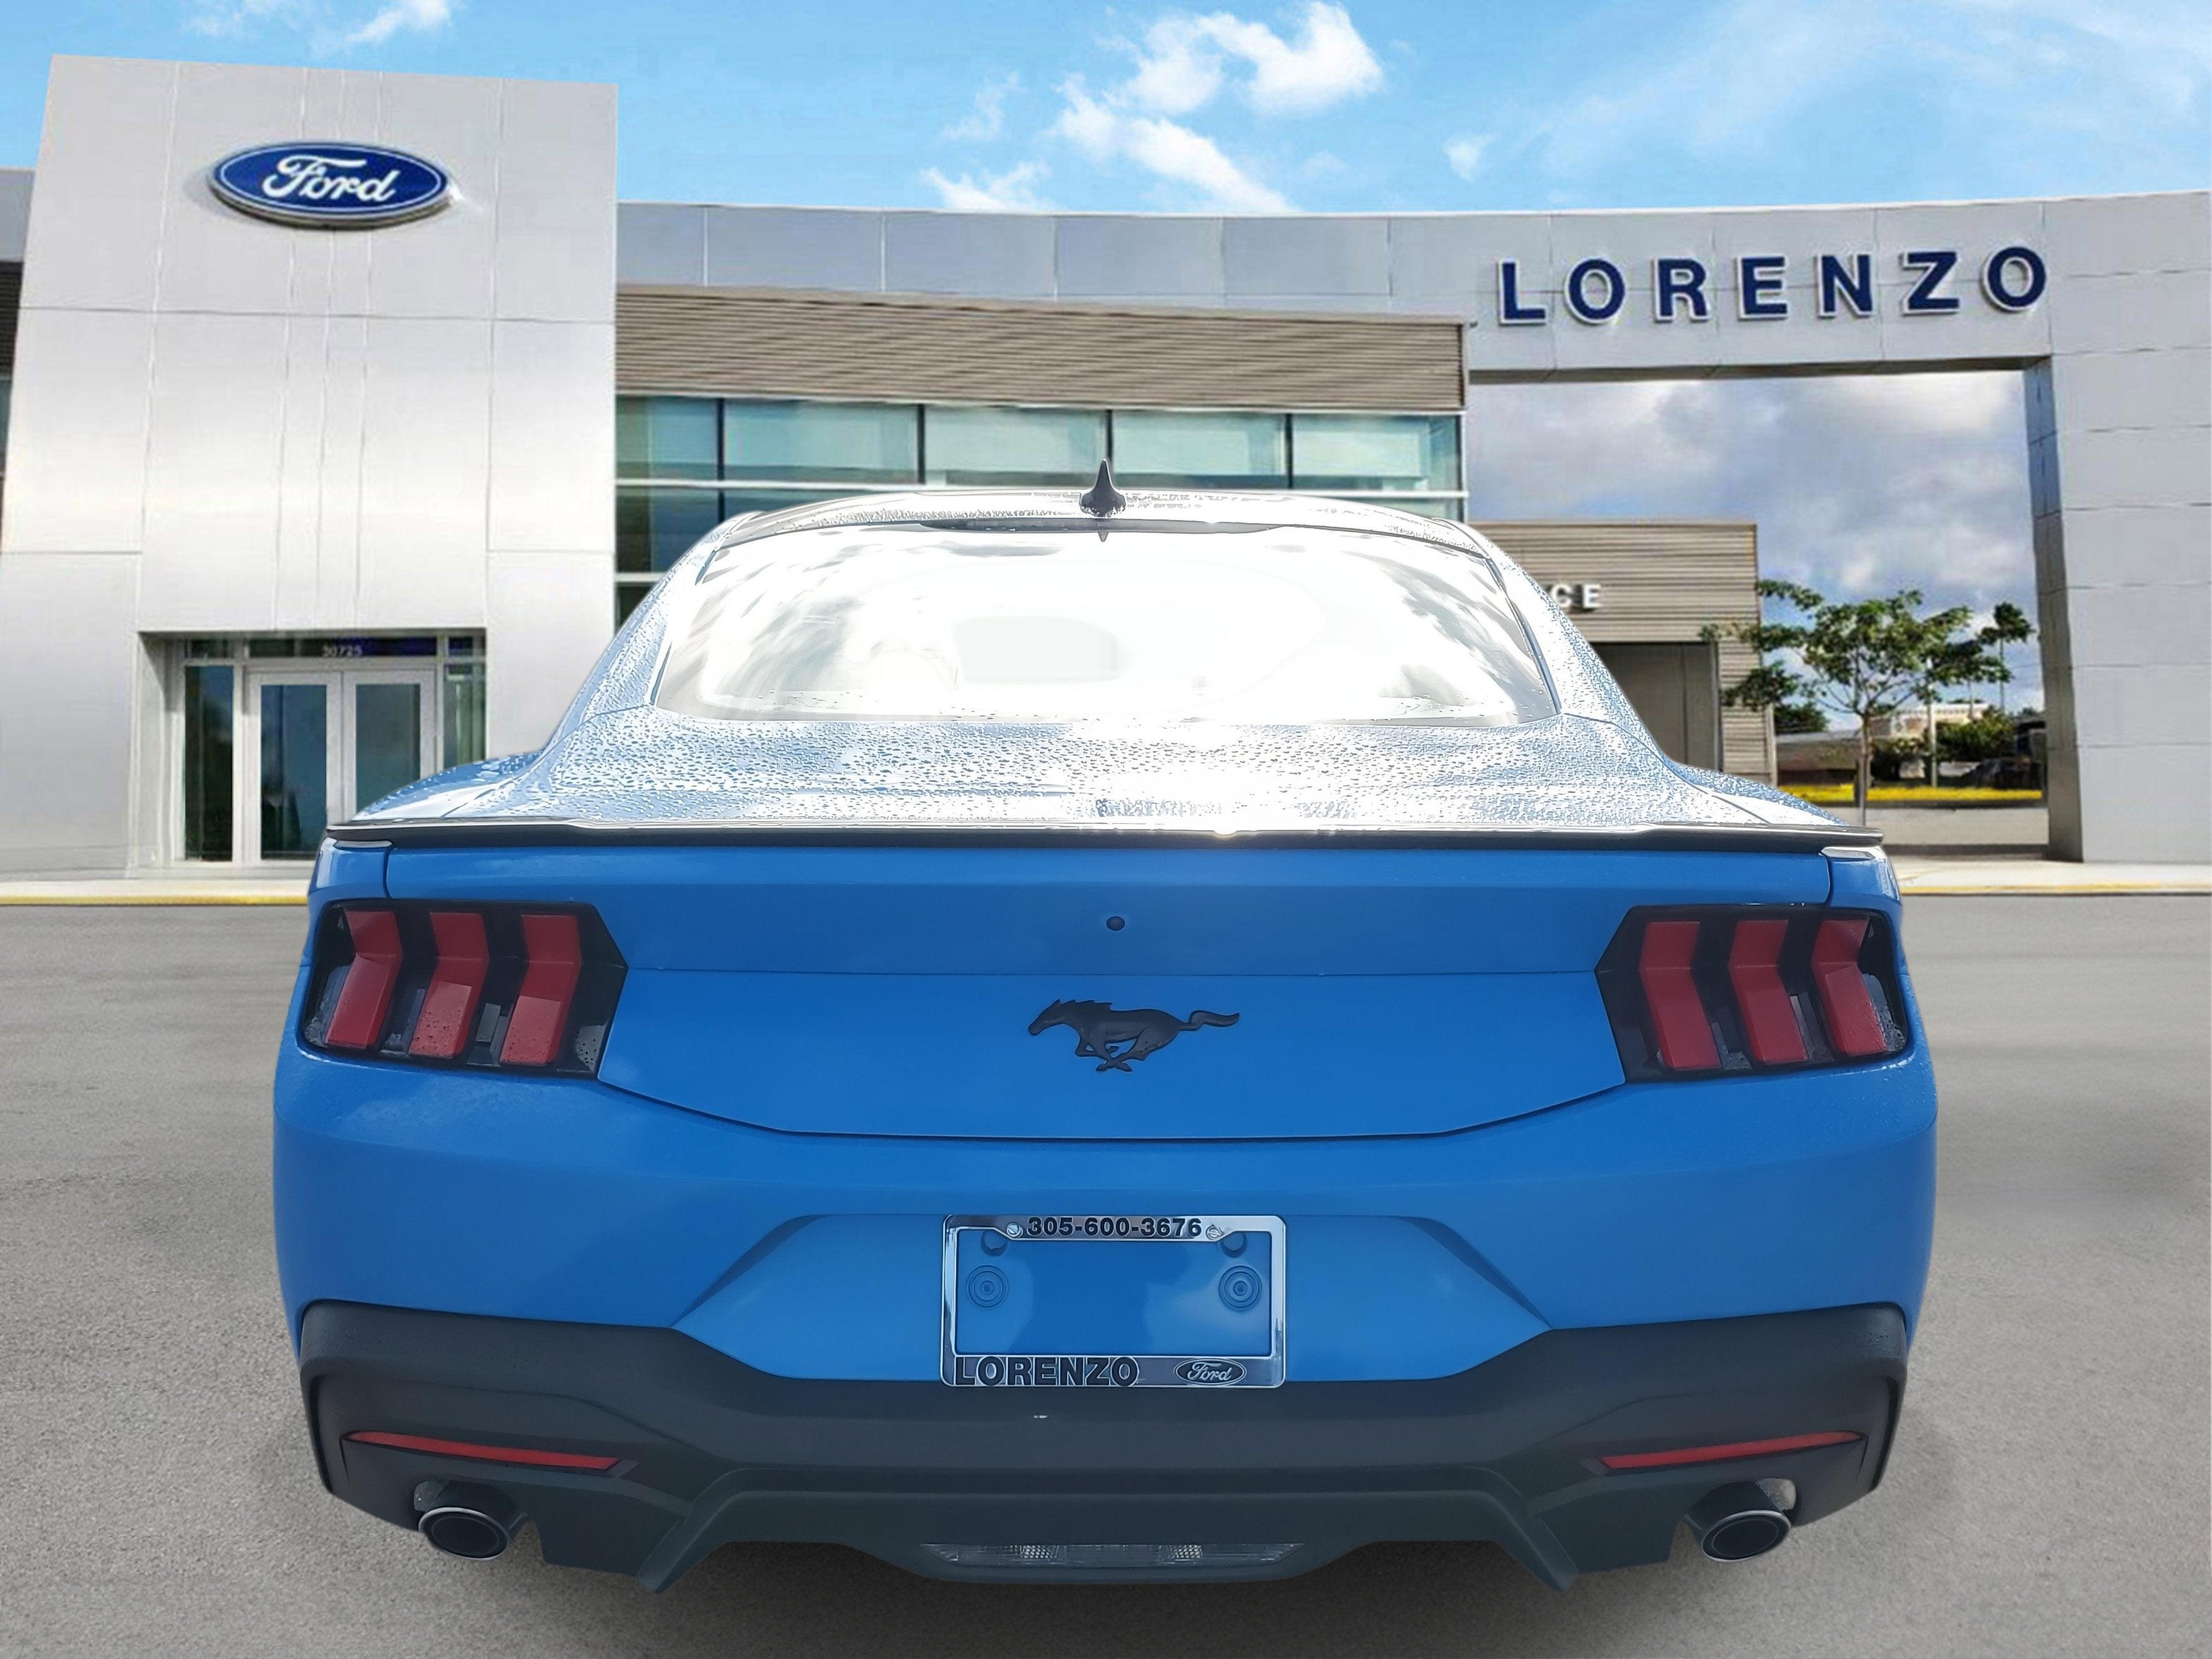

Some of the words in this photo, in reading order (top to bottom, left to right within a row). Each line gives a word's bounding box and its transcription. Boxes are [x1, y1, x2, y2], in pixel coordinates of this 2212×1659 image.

[263, 154, 401, 202] Ford
[1497, 246, 2047, 325] LORENZO
[1027, 1216, 1202, 1237] 305-600-3676
[954, 1355, 1140, 1386] LORENZO
[1187, 1362, 1232, 1381] Ford
